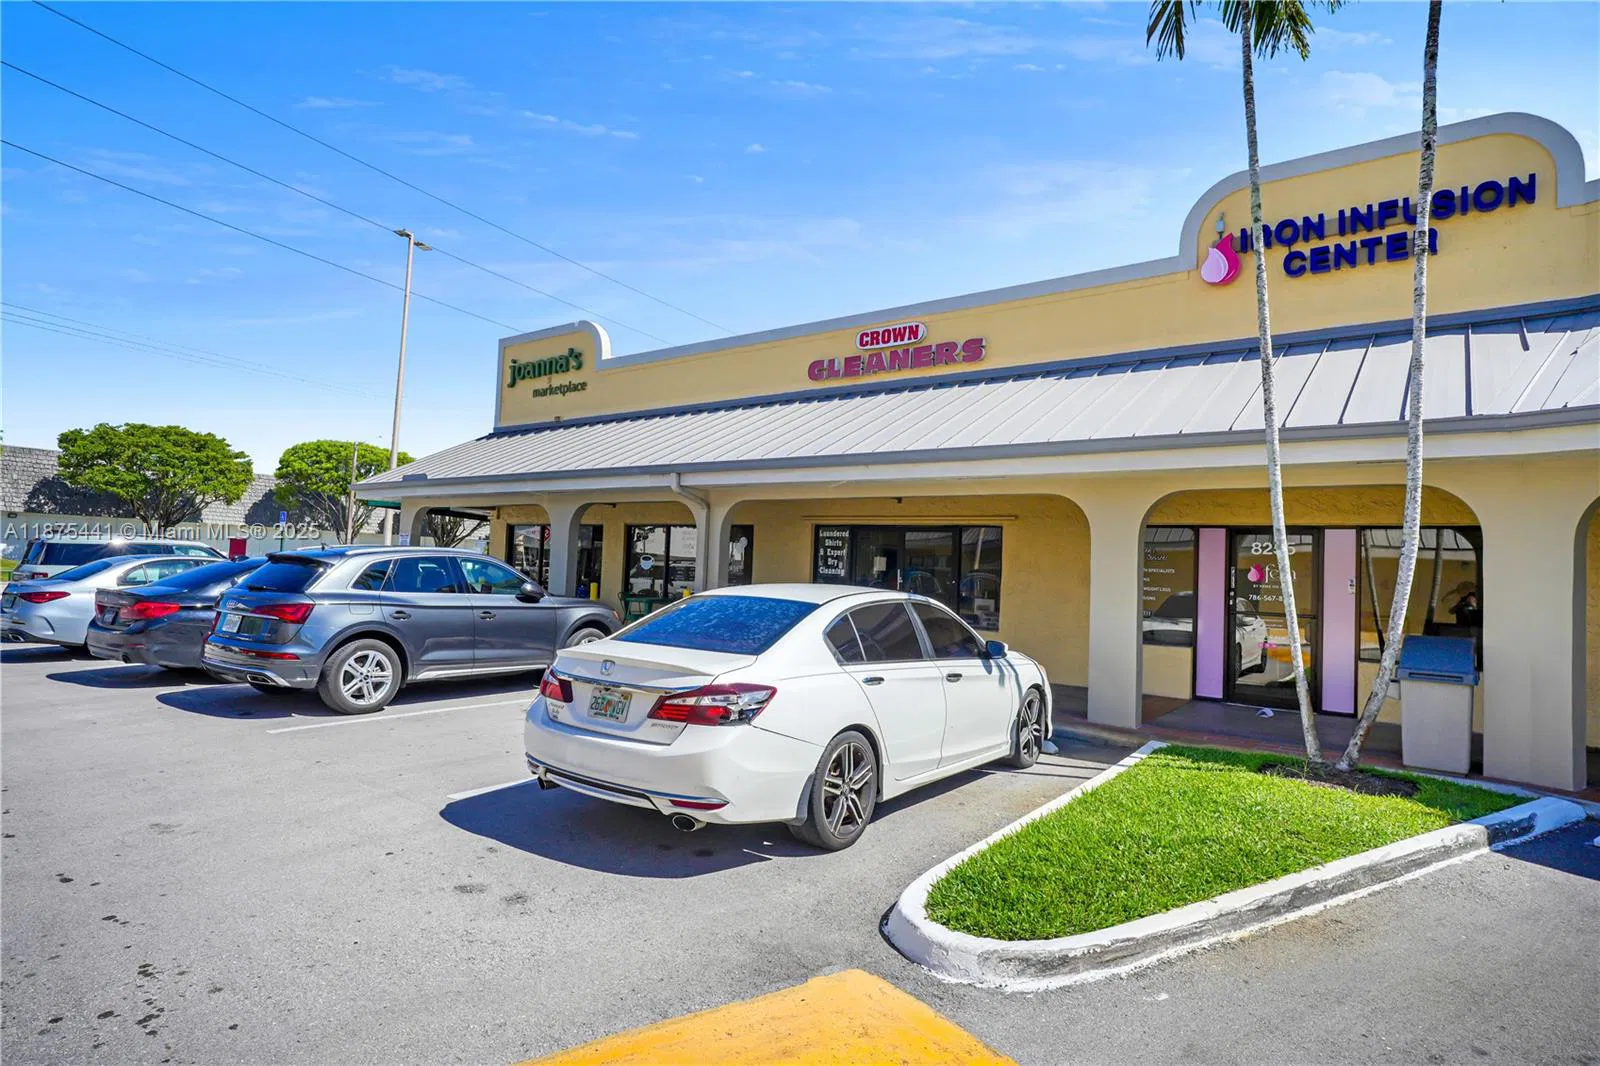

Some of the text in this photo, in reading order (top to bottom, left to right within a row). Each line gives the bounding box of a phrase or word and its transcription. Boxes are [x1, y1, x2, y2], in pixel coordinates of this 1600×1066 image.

[1240, 172, 1537, 254] IRON INFUSION
[858, 324, 920, 348] CROWN
[807, 337, 986, 382] CLEANERS
[507, 347, 584, 389] joanna's
[532, 380, 588, 398] marketplace
[825, 539, 842, 547] Shirts
[1251, 542, 1296, 556] 825
[827, 548, 846, 558] Expert
[827, 557, 838, 567] Dry
[819, 566, 845, 577] Cleaning
